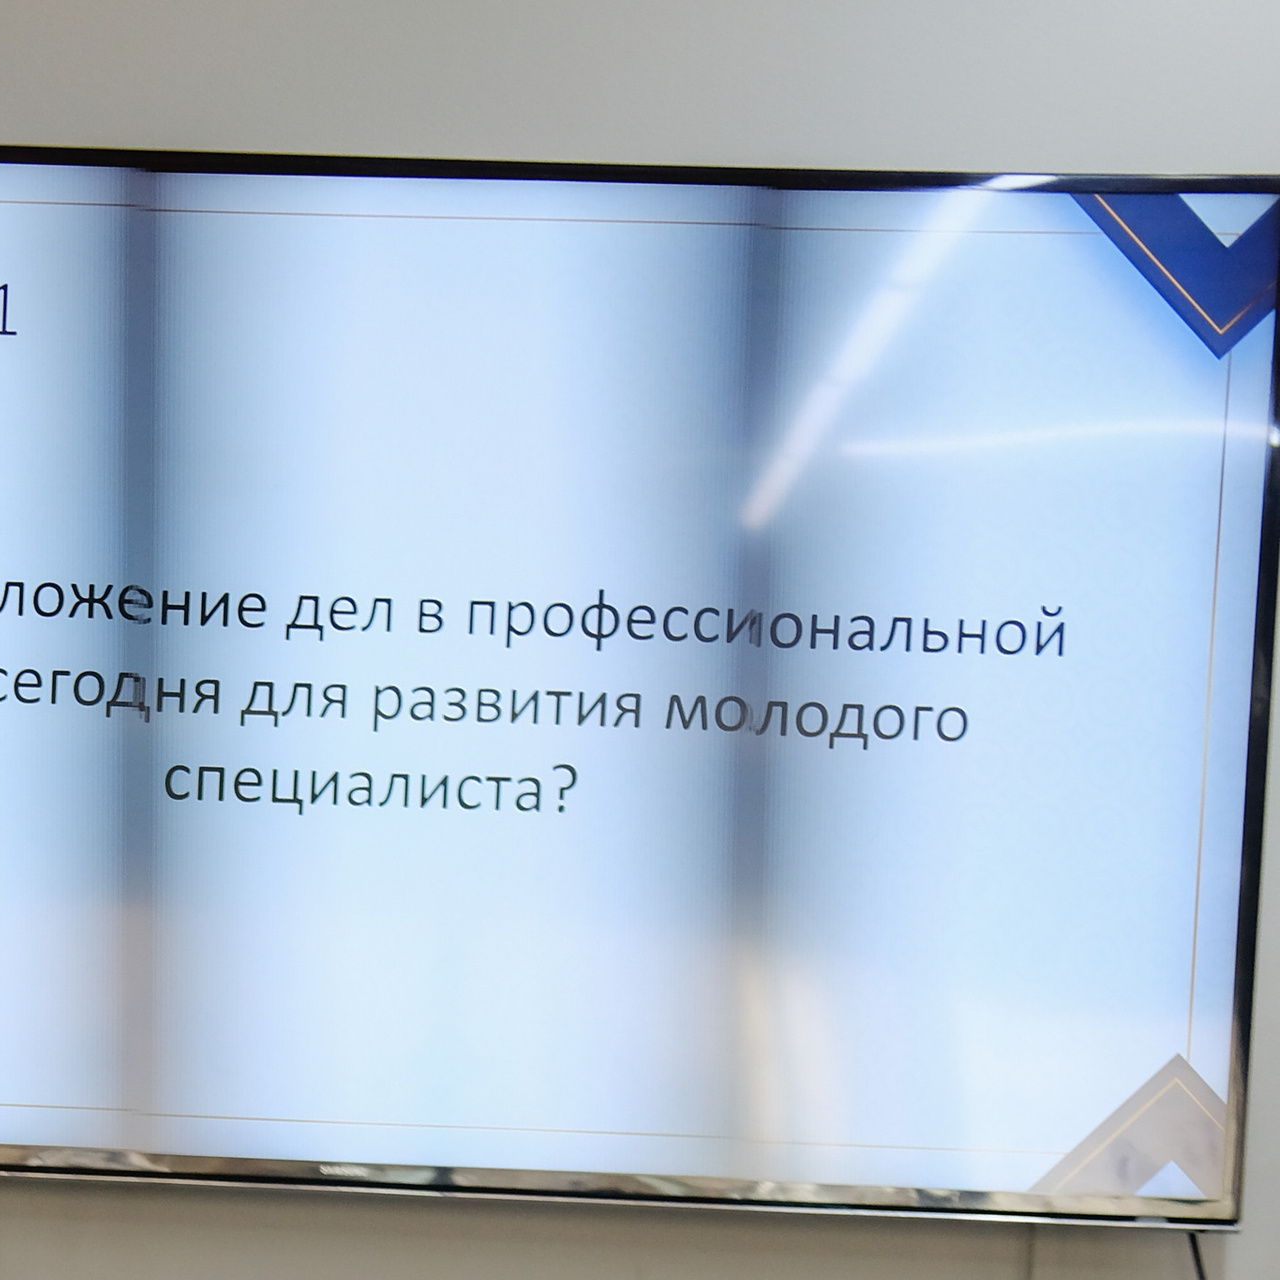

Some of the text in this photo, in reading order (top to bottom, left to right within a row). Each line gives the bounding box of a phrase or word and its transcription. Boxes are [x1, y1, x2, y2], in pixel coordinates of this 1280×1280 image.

[286, 592, 393, 644] дел
[419, 595, 444, 633] в
[468, 590, 1067, 659] профессиональной
[241, 676, 348, 727] для
[374, 683, 642, 744] развития
[665, 695, 969, 751] молодого
[164, 762, 578, 816] специалиста?
